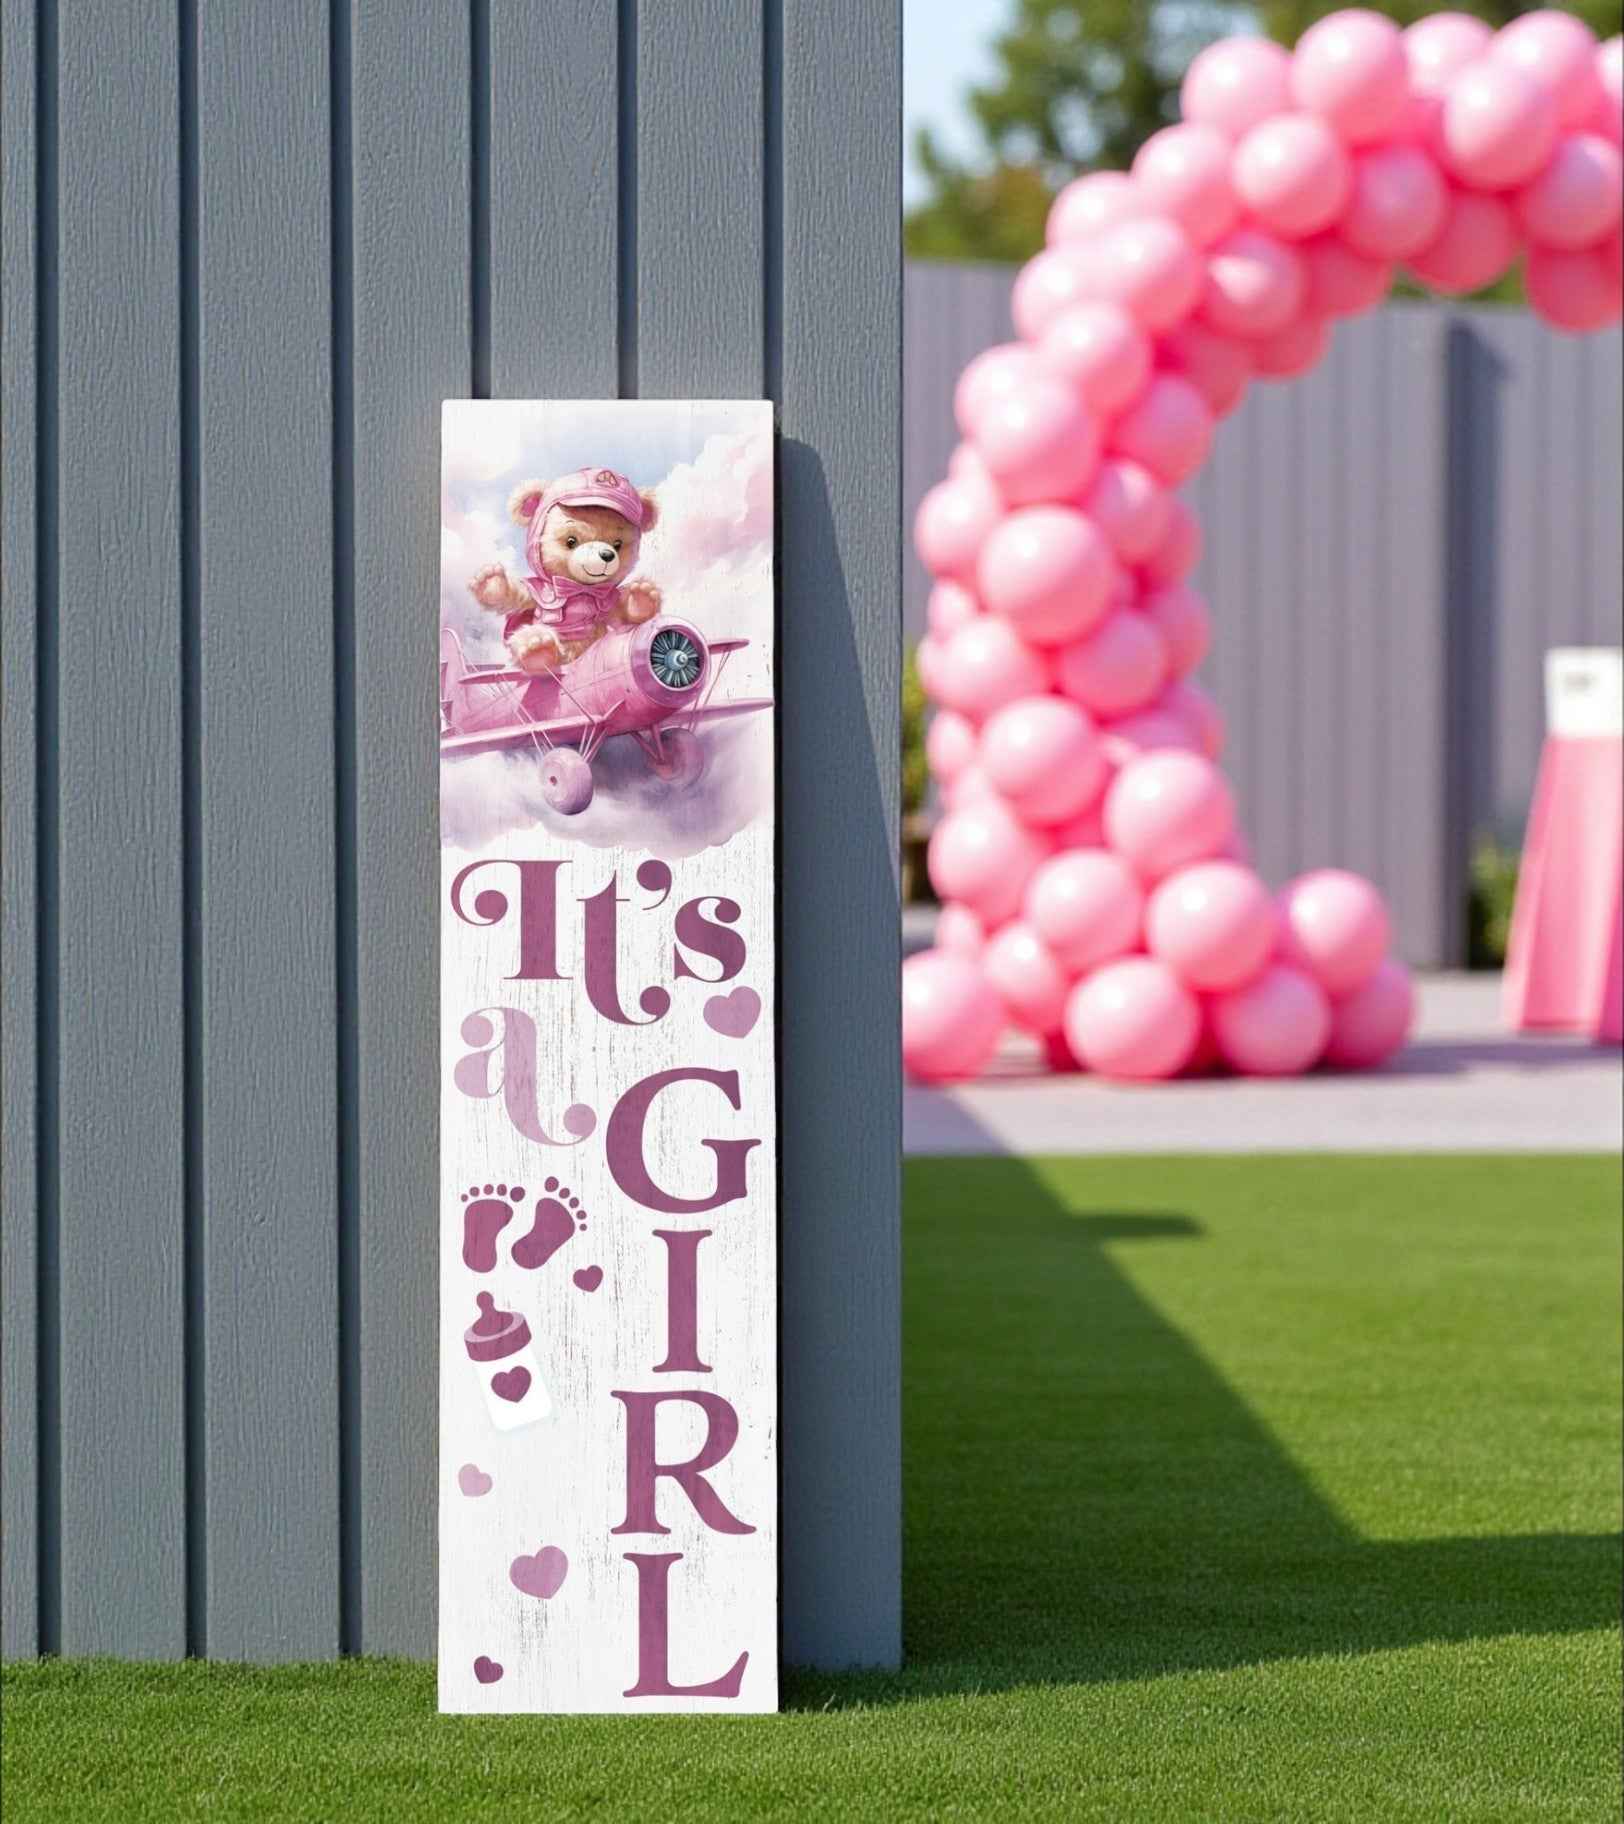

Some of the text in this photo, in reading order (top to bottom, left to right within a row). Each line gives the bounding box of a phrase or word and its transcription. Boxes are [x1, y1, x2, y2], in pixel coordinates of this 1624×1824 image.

[450, 859, 747, 1026] It's
[453, 1006, 597, 1146] a
[605, 1066, 762, 1698] GIRL
